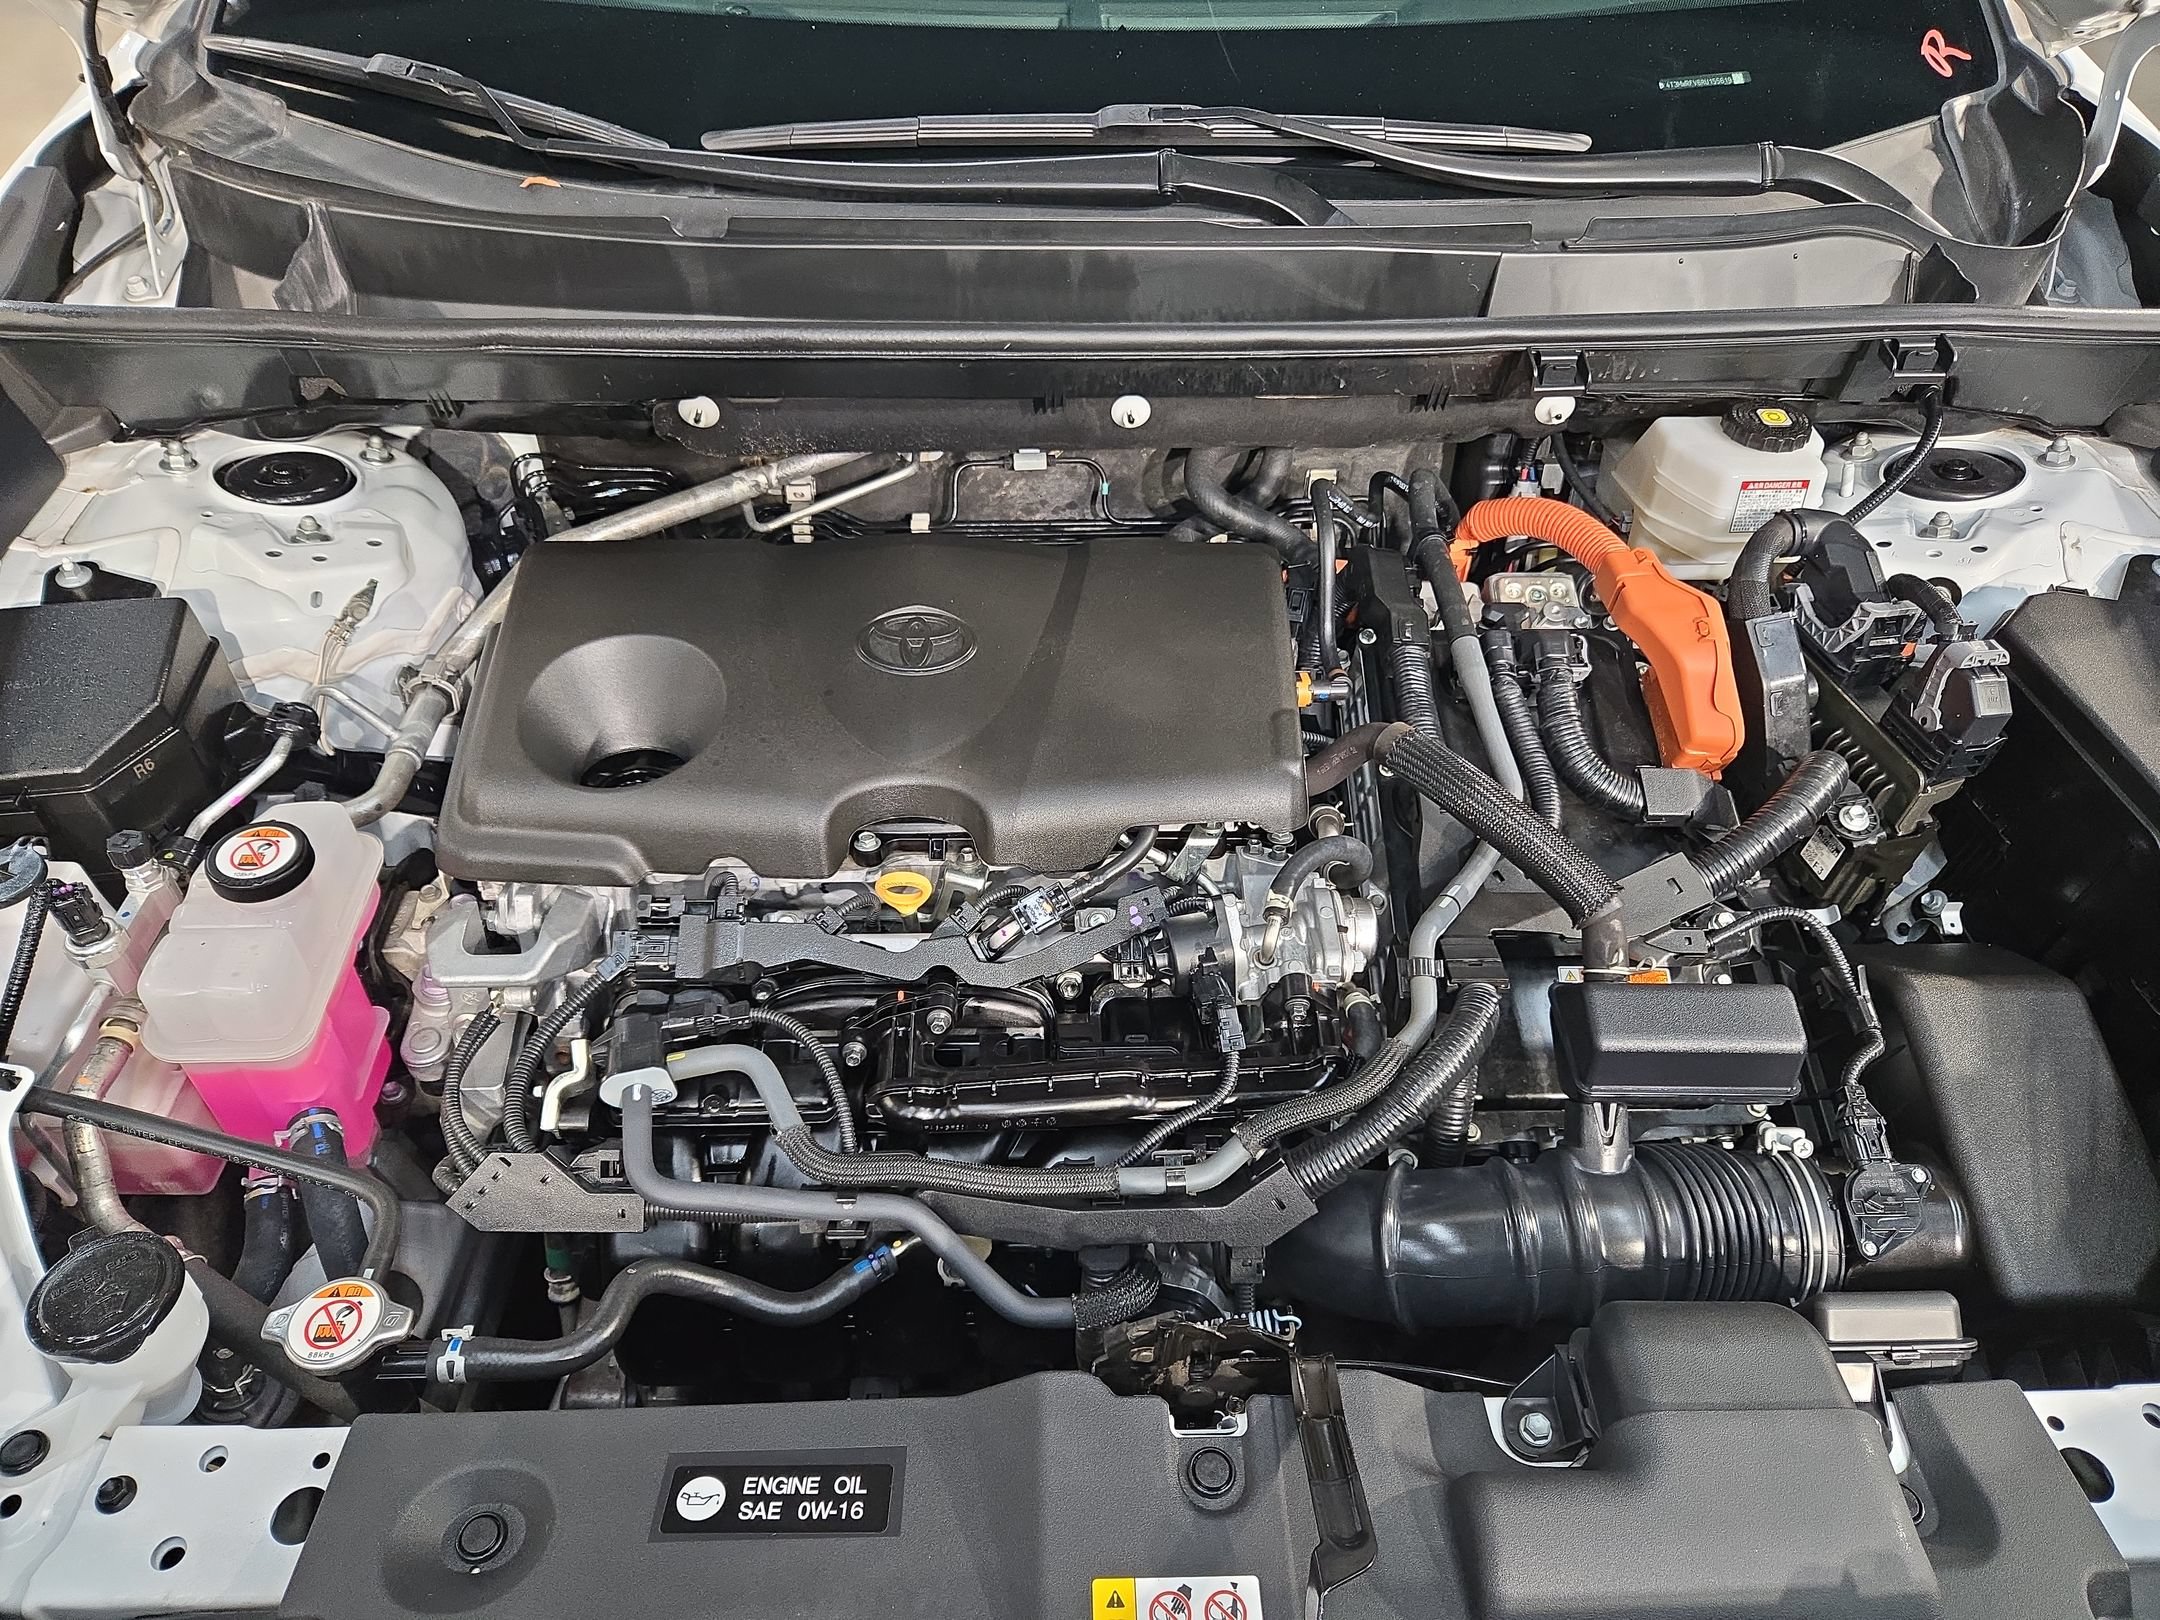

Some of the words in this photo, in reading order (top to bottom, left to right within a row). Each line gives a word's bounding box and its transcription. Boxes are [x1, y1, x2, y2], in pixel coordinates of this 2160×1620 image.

[1921, 29, 1971, 77] R
[1764, 481, 1791, 489] DANGER
[133, 758, 155, 779] R6
[743, 1476, 821, 1495] ENGINE
[834, 1476, 868, 1495] OIL
[738, 1501, 782, 1520] SAE
[797, 1501, 864, 1520] 0W-16
